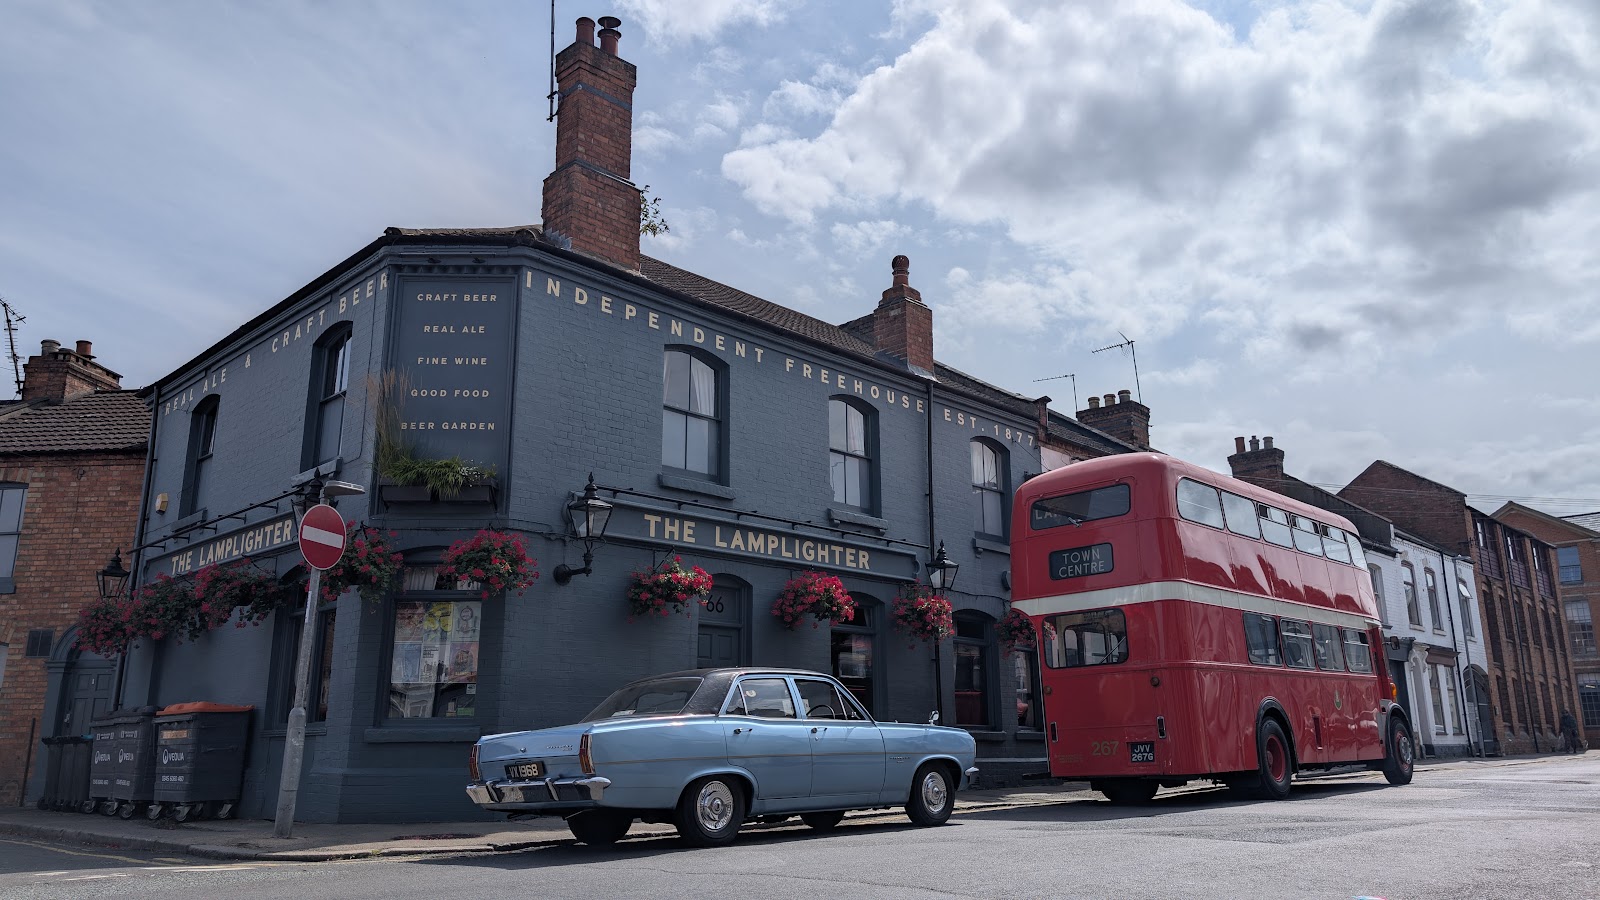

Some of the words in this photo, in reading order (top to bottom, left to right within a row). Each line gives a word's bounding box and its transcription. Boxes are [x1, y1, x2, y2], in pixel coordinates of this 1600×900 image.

[417, 293, 458, 301] CRAFT
[463, 294, 497, 302] BEER
[423, 325, 456, 333] REAL
[462, 325, 485, 333] ALE
[164, 388, 194, 416] REAL
[202, 368, 227, 394] ALE
[244, 354, 251, 369] &
[271, 309, 325, 353] CRAFT
[339, 272, 388, 314] BEER
[417, 357, 448, 365] FINE
[454, 357, 488, 365] WINE
[526, 271, 764, 363] INDEPENDENT
[785, 358, 925, 414] FREEHOUSE
[944, 408, 985, 432] EST.
[993, 424, 1034, 447] 1877
[410, 389, 448, 397] GOOD
[454, 389, 490, 398] FOOD
[401, 422, 435, 430] BEER
[441, 422, 495, 430] GARDEN
[171, 550, 193, 575] THE
[198, 519, 293, 567] LAMPLIGHTER
[643, 513, 697, 543] THE
[715, 525, 870, 570] LAMPLIGHTER
[1062, 548, 1100, 565] TOWN
[1058, 560, 1105, 578] CENTRE
[706, 594, 724, 613] 66
[1091, 740, 1119, 756] 267
[1134, 744, 1151, 753] JVV
[1131, 752, 1154, 762] 267G
